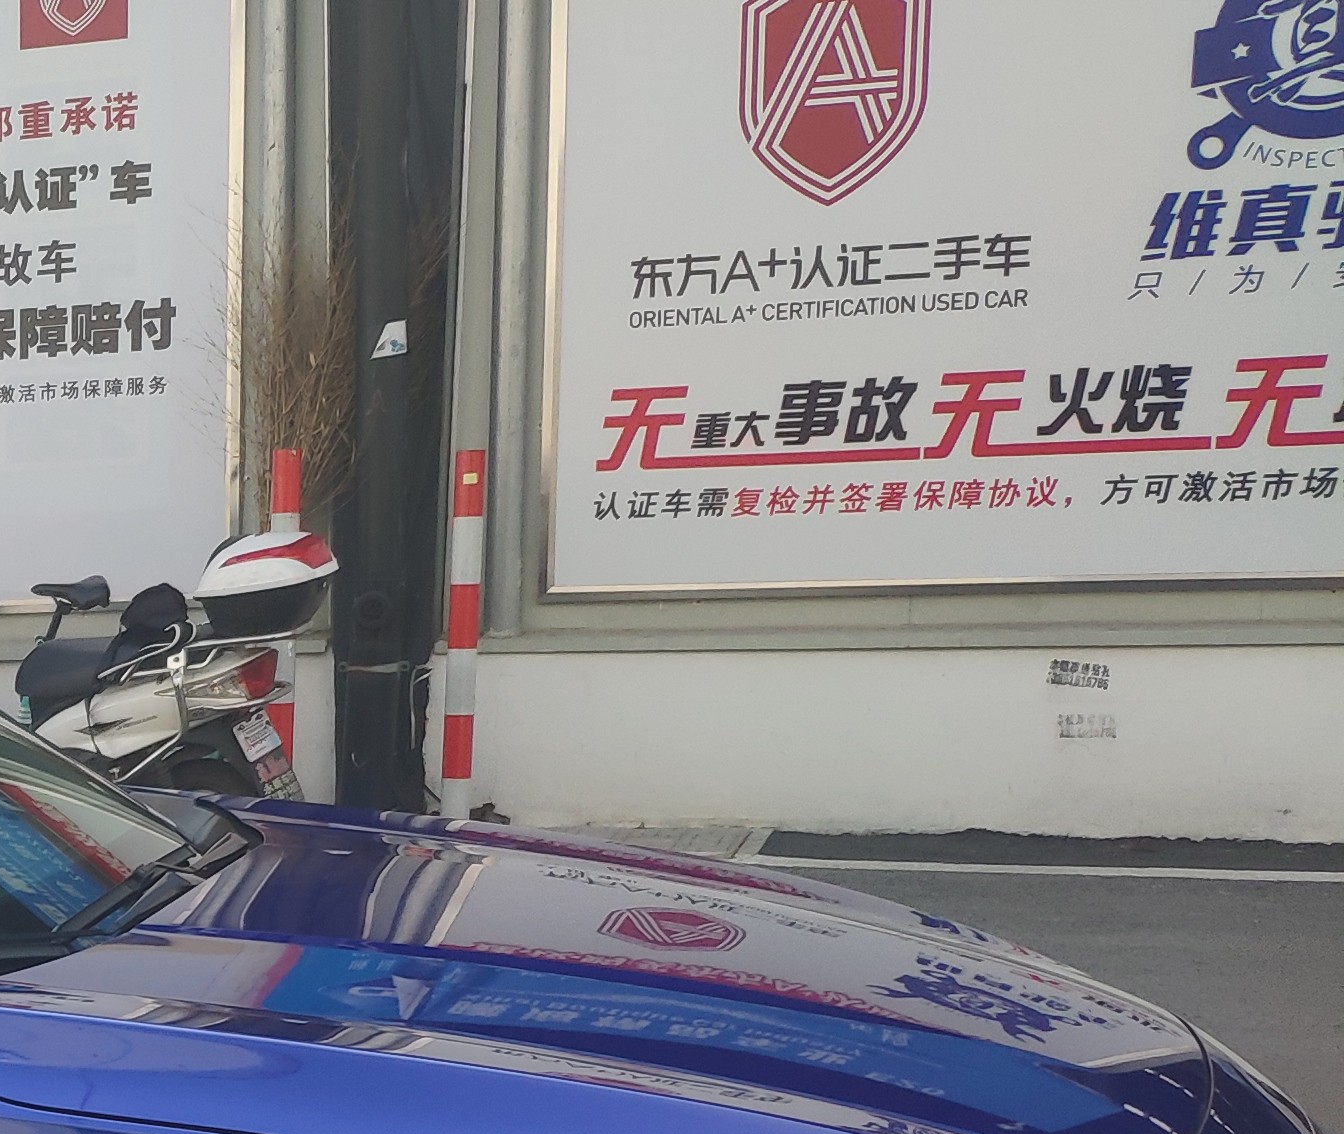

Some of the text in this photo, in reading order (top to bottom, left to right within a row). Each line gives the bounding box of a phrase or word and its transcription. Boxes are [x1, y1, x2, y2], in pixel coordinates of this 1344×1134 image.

[1243, 142, 1344, 168] INSPEC
[630, 233, 1032, 299] 东方A+认证二手车
[629, 288, 1029, 329] ORIENTAL A+ CERTIFICATION USED CAR
[593, 467, 1344, 522] 认证车需复检并签署保障协议，方可激活市场
